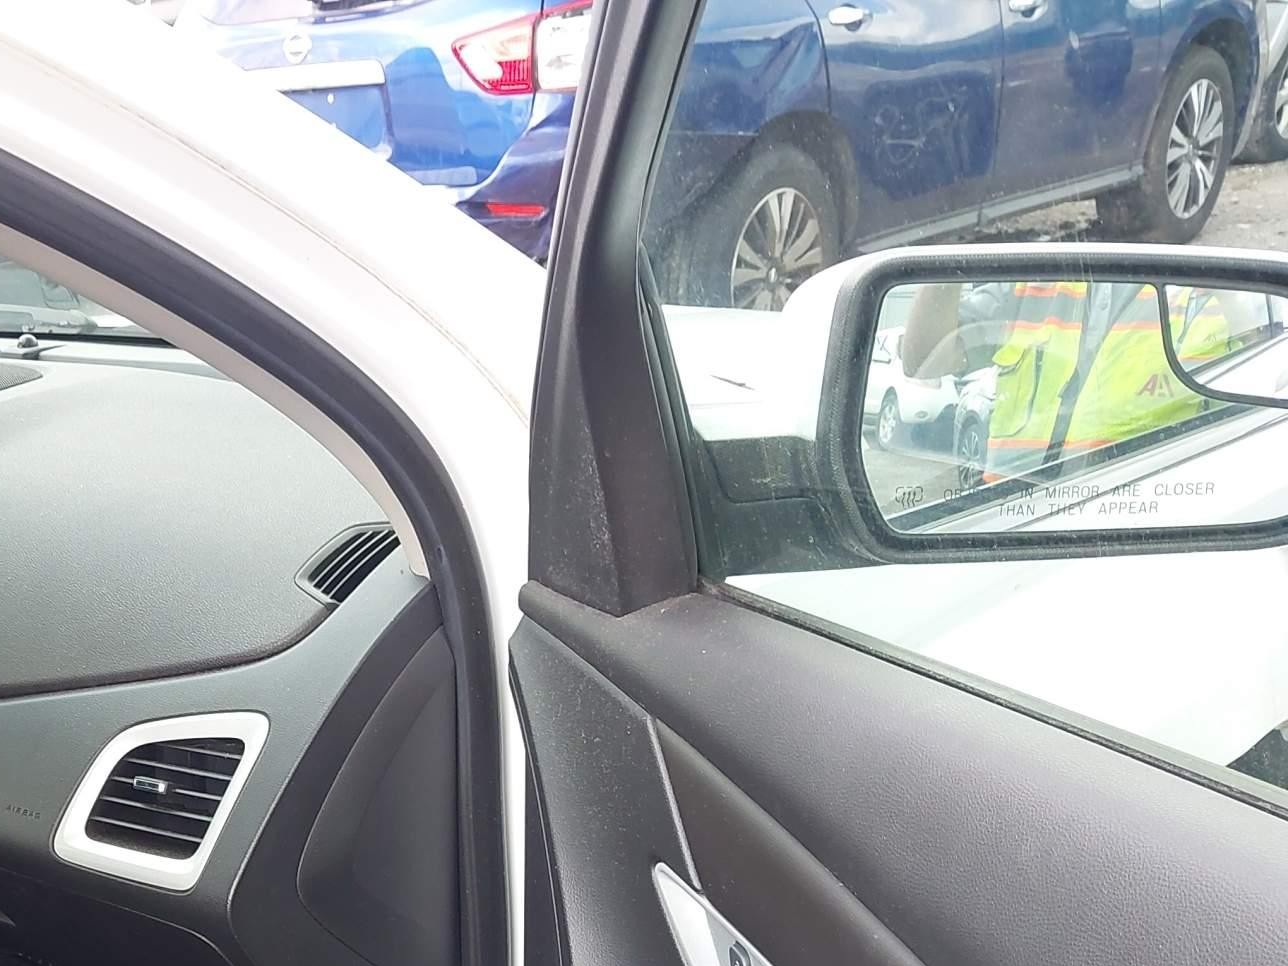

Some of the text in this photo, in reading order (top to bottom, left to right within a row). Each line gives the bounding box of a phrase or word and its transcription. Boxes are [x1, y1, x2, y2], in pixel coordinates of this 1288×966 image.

[1020, 487, 1034, 499] IN
[1044, 485, 1100, 499] MIRROR
[1111, 483, 1142, 497] ARE
[1153, 481, 1216, 497] CLOSER
[998, 500, 1159, 517] THAN THEY APPEAR
